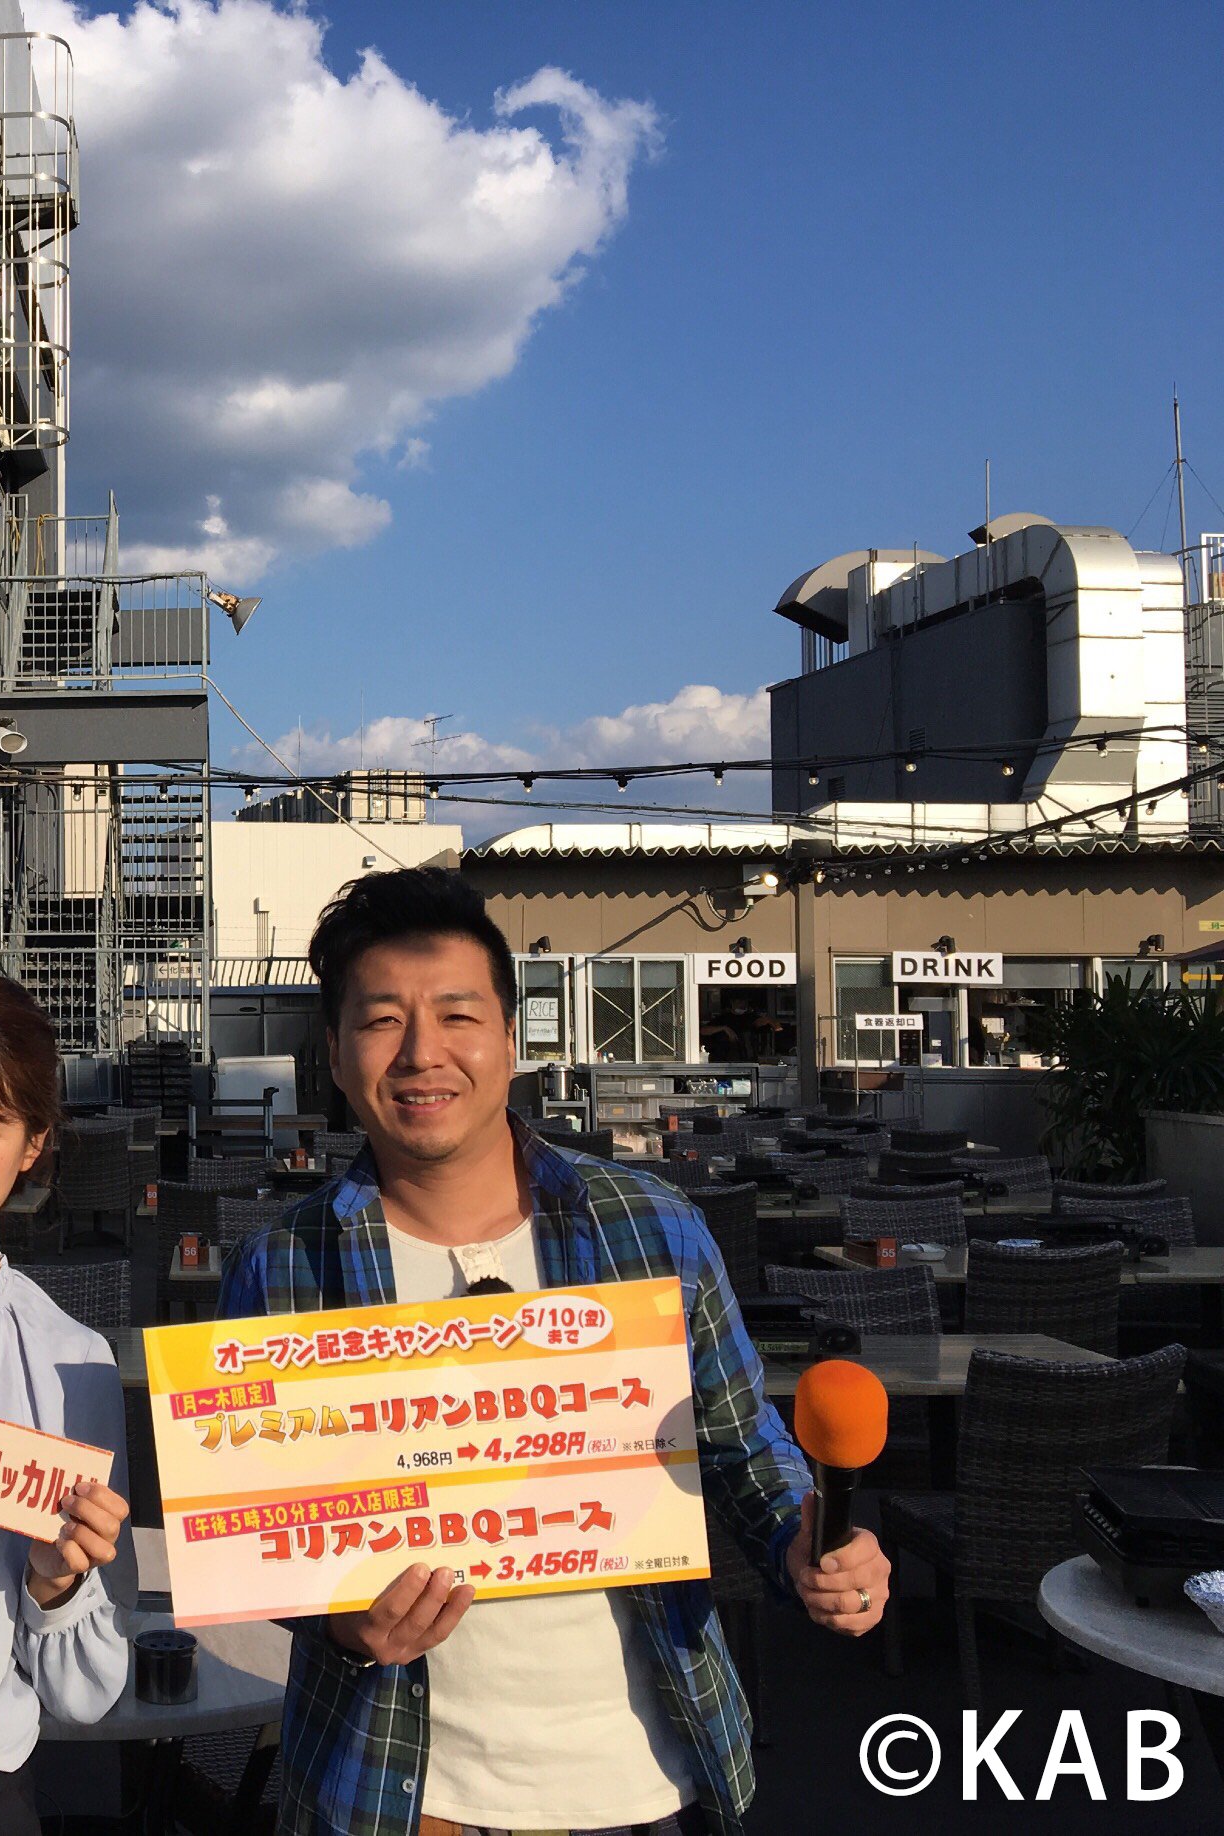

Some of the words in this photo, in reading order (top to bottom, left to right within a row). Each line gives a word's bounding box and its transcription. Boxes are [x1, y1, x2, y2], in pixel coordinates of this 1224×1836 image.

[706, 958, 787, 979] FOOD
[899, 956, 996, 978] DRINK
[529, 1000, 556, 1017] RICE
[863, 1017, 916, 1027] 食器返却口
[184, 1247, 197, 1256] 56
[881, 1248, 896, 1257] 55
[521, 1307, 605, 1328] 5/10(金)
[216, 1316, 518, 1369] オープン記念キャンペーン
[547, 1329, 580, 1345] まで
[194, 1377, 652, 1451] プレミアムコリアンBBQコース
[396, 1451, 453, 1470] 4,968円
[483, 1431, 587, 1463] 4,298円
[259, 1500, 614, 1560] コリアンBBQコース
[496, 1549, 599, 1581] 3,456円
